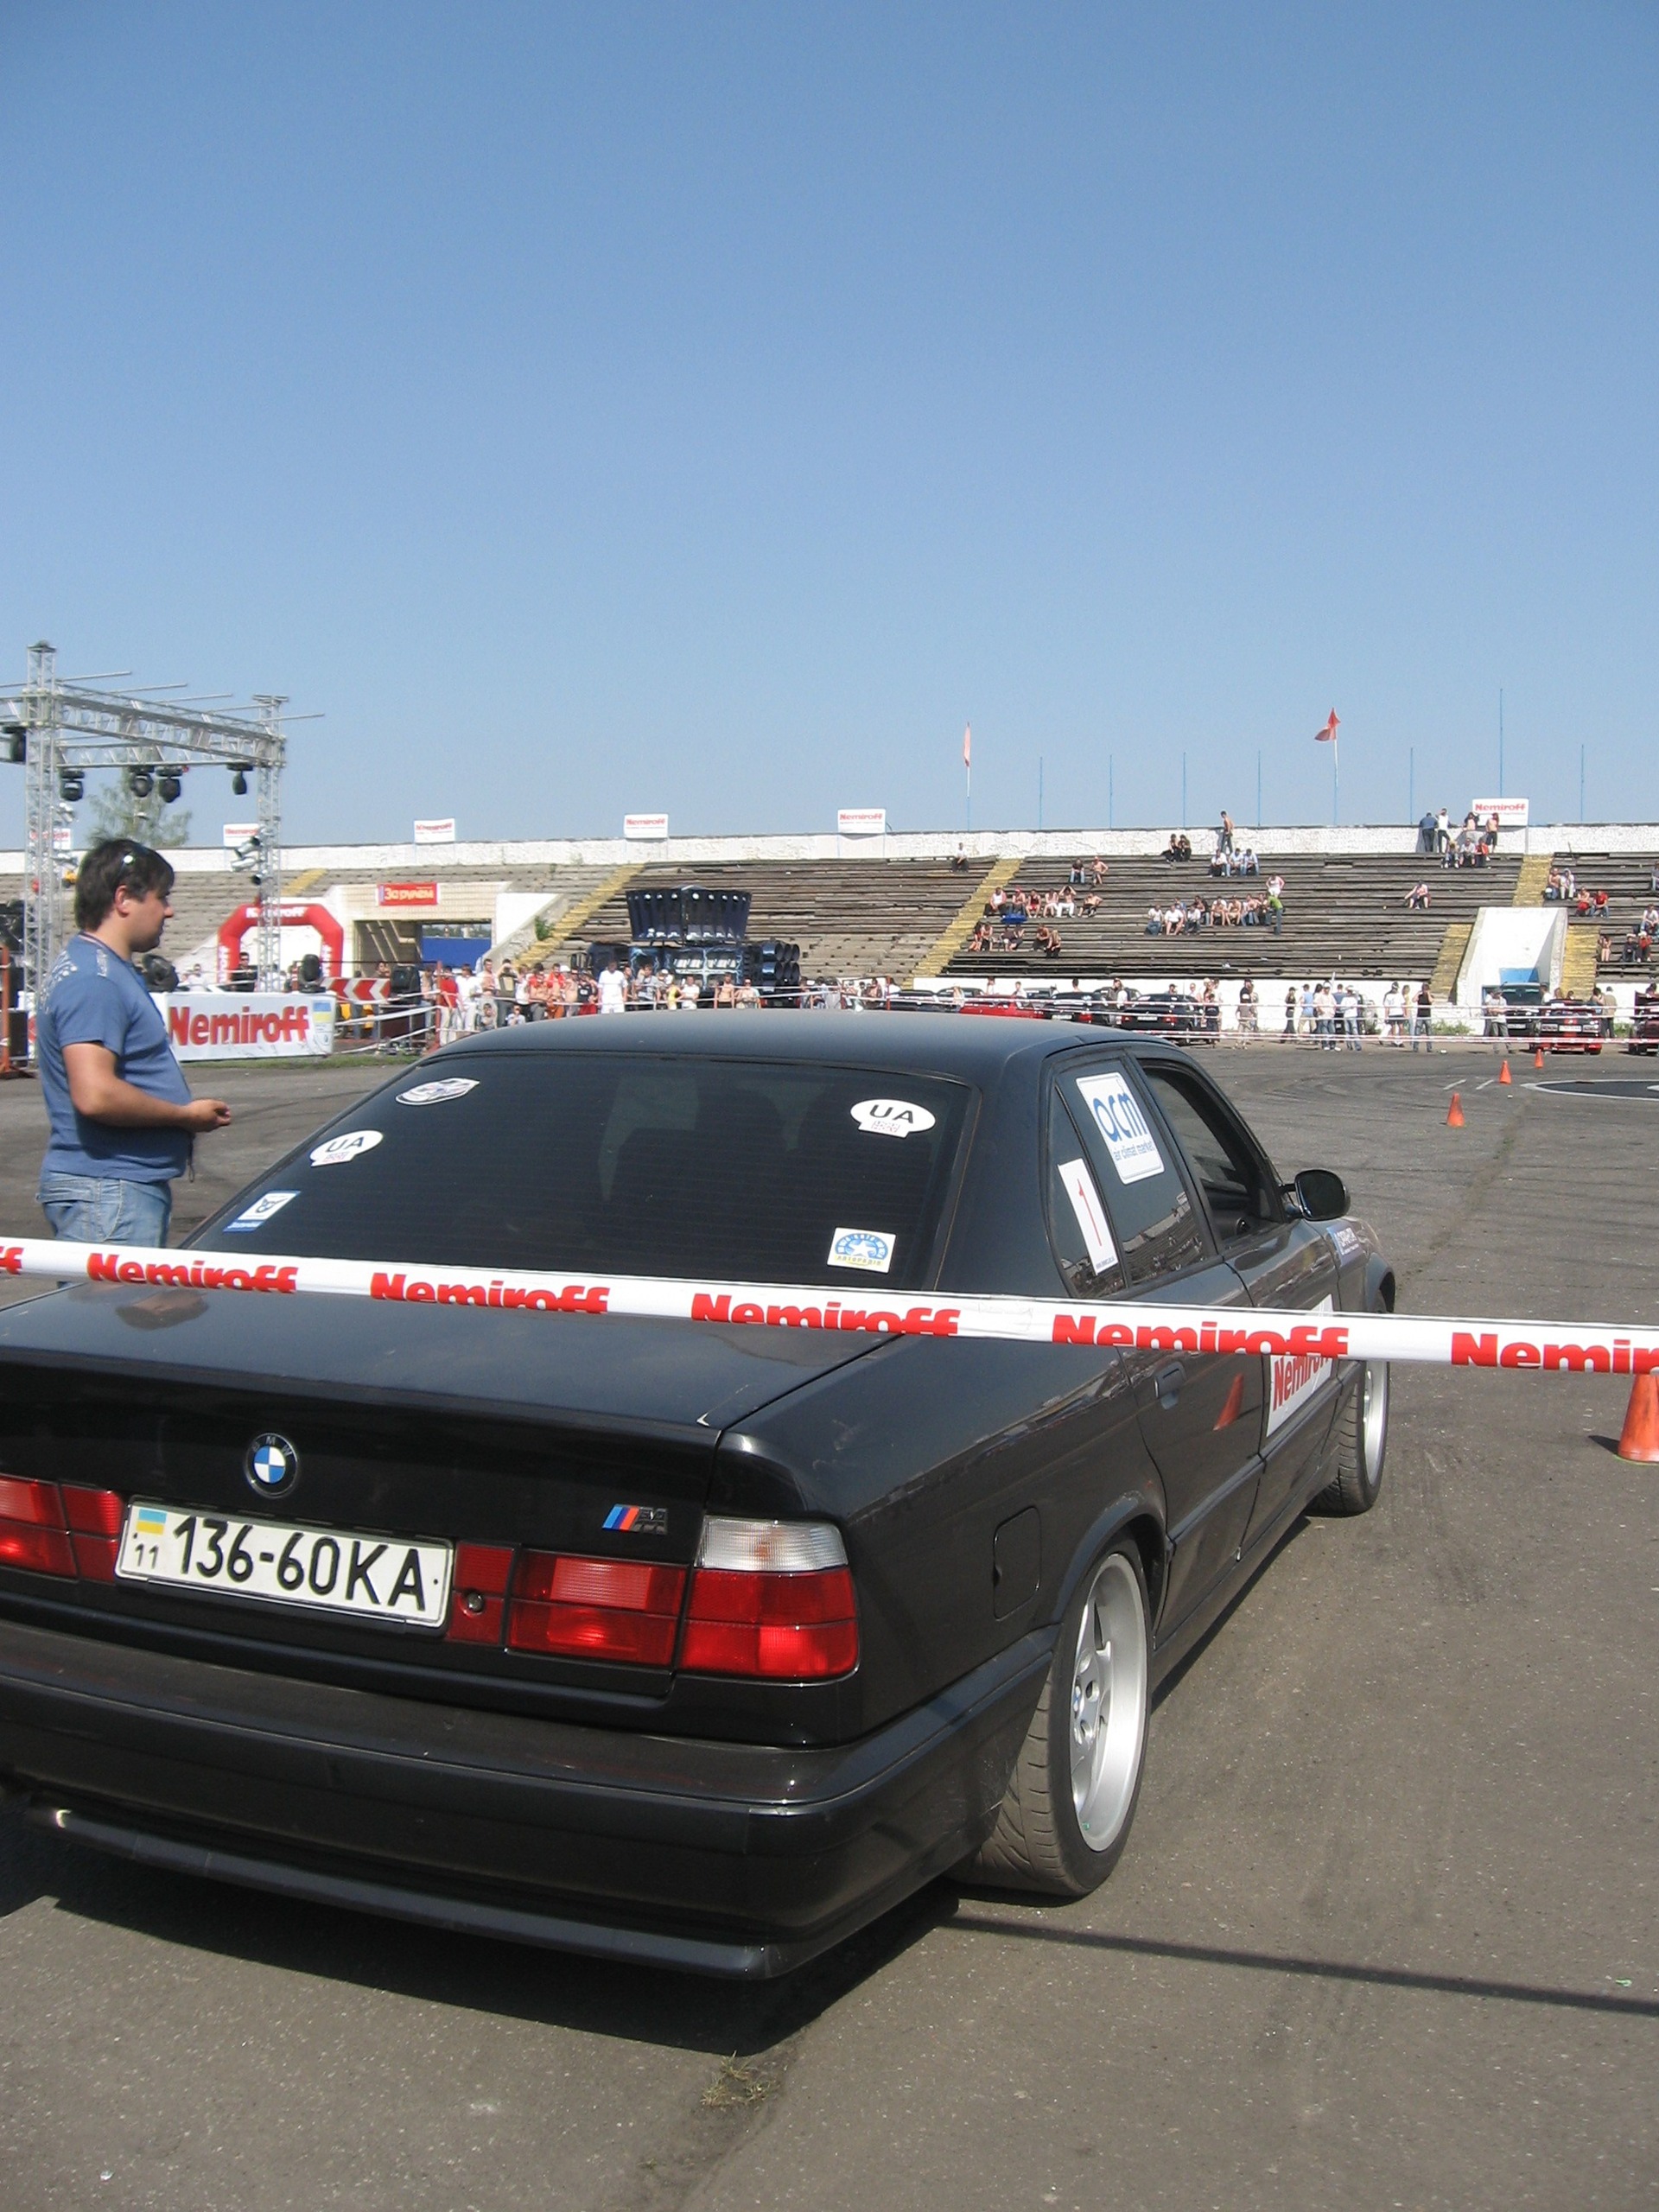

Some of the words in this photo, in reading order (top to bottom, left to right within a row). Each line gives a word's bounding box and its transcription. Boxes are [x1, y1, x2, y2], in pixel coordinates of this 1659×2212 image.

[168, 1006, 309, 1046] Nemiroff
[869, 1104, 914, 1124] UA
[325, 1135, 365, 1153] UA
[86, 1253, 299, 1293] Nemiroff
[370, 1272, 610, 1314] Nemiroff
[691, 1293, 961, 1336] Nemiroff
[1052, 1314, 1349, 1358] Nemiroff
[251, 1435, 293, 1458] BMW
[133, 1543, 160, 1569] 11
